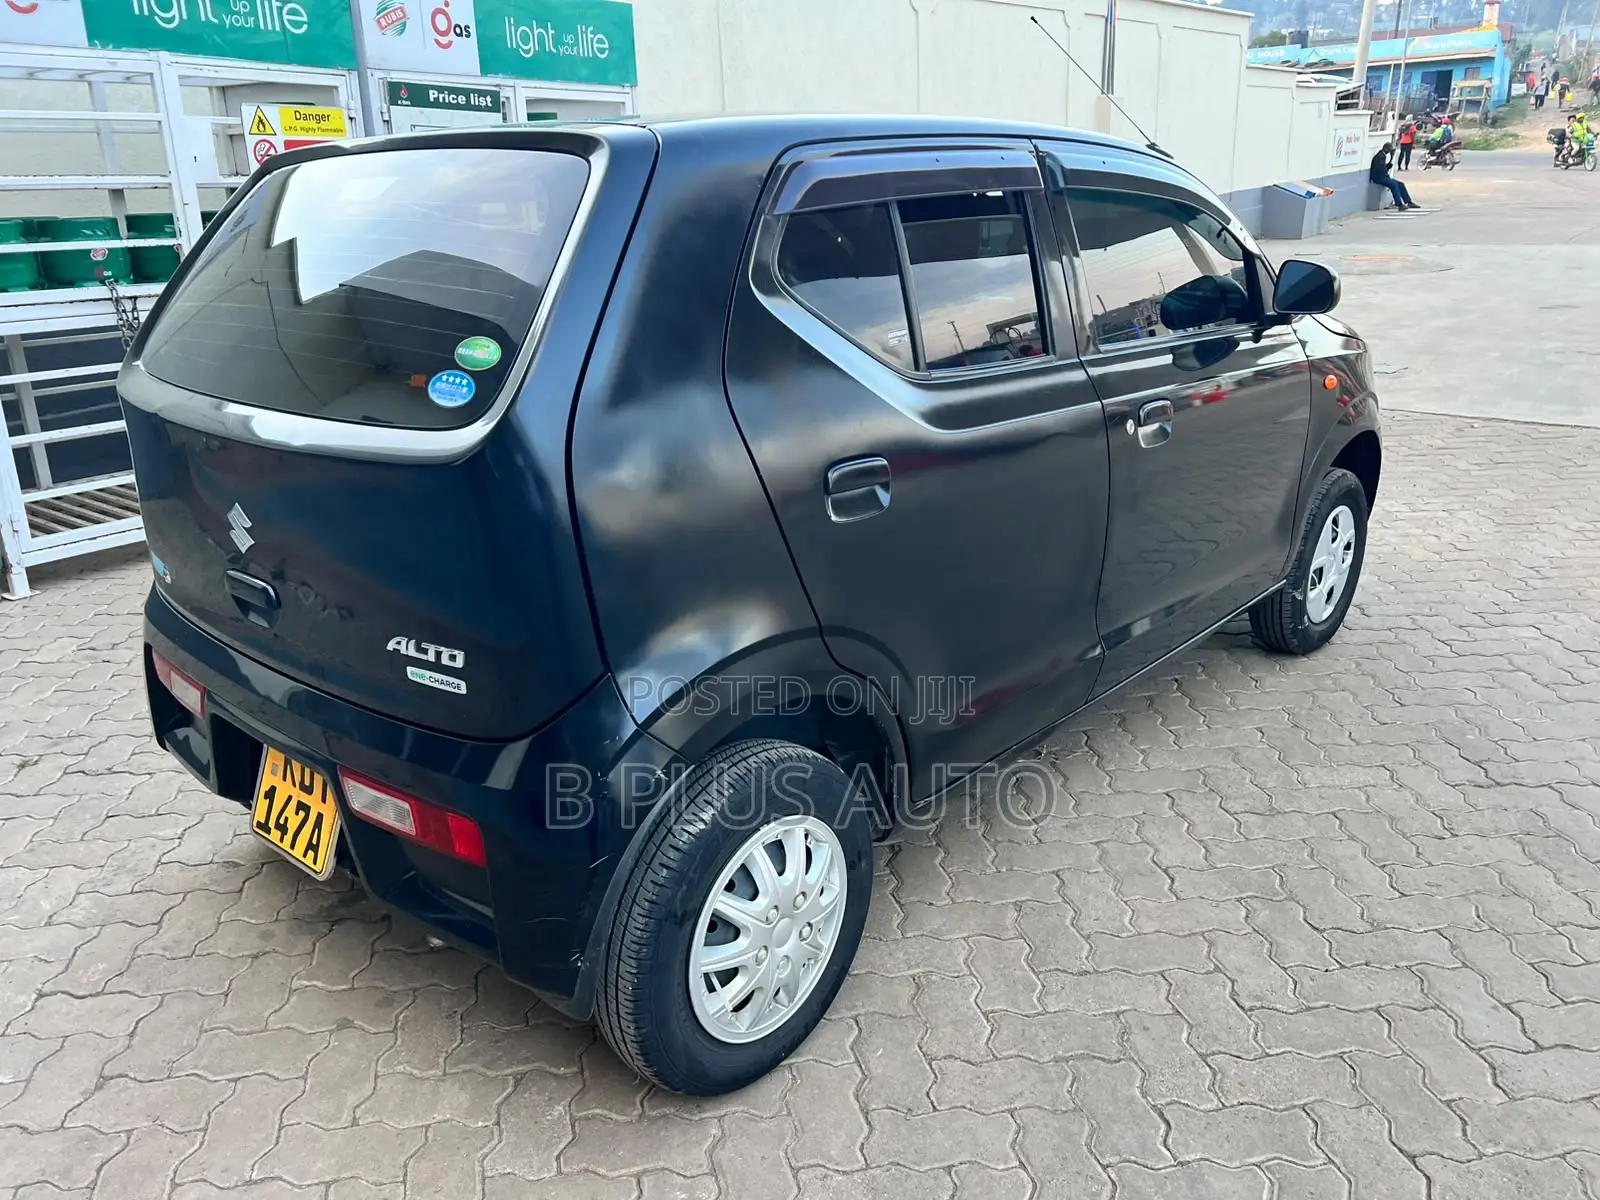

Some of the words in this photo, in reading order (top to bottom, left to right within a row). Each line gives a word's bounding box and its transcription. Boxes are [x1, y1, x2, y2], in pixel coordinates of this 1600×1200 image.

[222, 13, 255, 29] your
[255, 0, 308, 34] life
[380, 8, 404, 28] RUBIS
[504, 16, 556, 58] light
[558, 44, 578, 56] your
[563, 33, 575, 44] up
[577, 24, 609, 58] life
[428, 89, 467, 104] Price
[470, 93, 493, 108] list
[294, 110, 331, 124] Danger
[386, 636, 465, 669] ALTO
[256, 784, 324, 866] 147A
